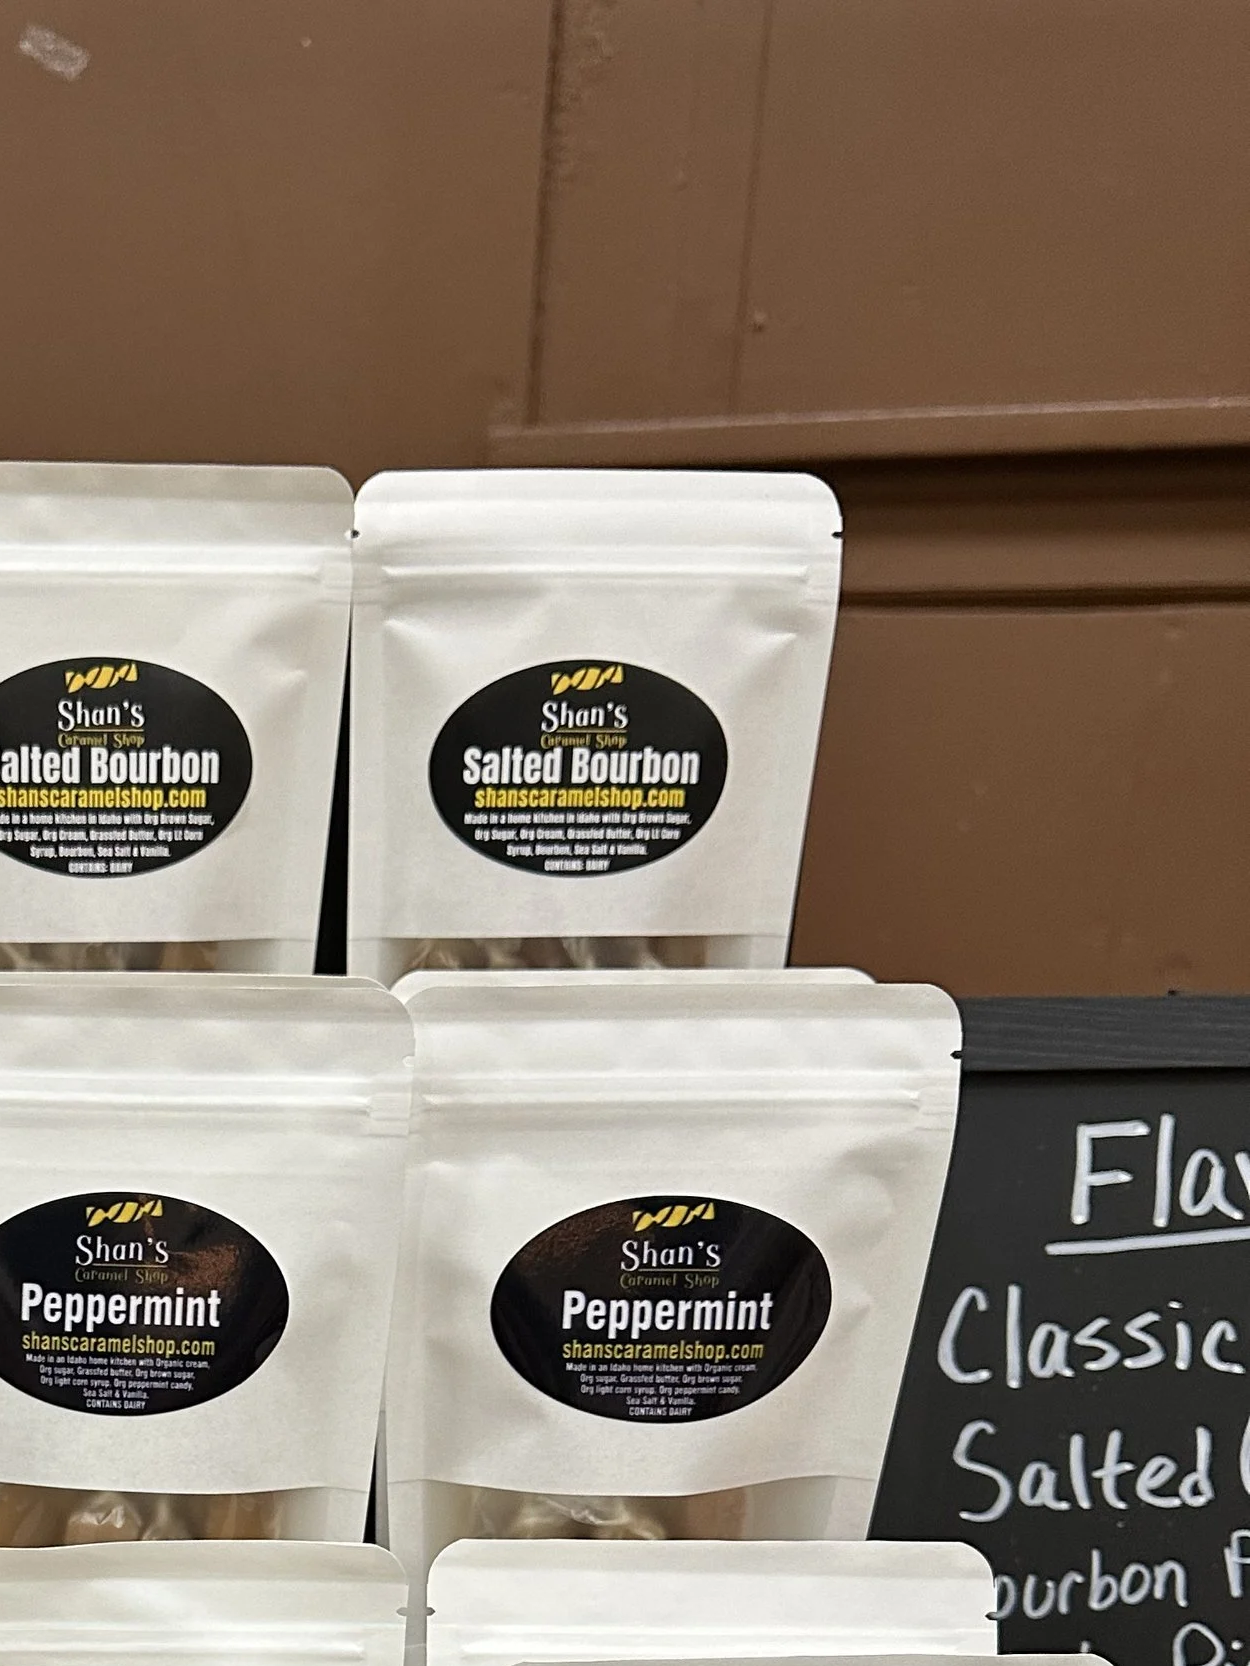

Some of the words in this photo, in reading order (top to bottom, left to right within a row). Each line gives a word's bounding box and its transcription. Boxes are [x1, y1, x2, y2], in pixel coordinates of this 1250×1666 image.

[57, 700, 144, 731] Shan's
[541, 701, 627, 732] Shan's
[57, 732, 107, 748] Caramel
[113, 733, 144, 748] Shop
[540, 733, 590, 749] Caramel
[595, 732, 626, 748] Shop
[90, 743, 219, 783] Bourbon
[462, 745, 562, 784] Salted
[571, 745, 699, 784] Bourbon
[474, 786, 684, 808] shanscaramelshop.com
[75, 1235, 168, 1266] Shan's
[620, 1239, 720, 1271] Shan's
[74, 1267, 127, 1282] Caramel
[134, 1268, 169, 1284] Shop
[619, 1272, 676, 1289] Caramel
[684, 1273, 719, 1288] Shop
[21, 1282, 220, 1332] Peppermint
[562, 1290, 772, 1339] Peppermint
[22, 1330, 214, 1357] shanscaramelshop.com
[938, 1284, 1246, 1389] Classic
[25, 1353, 45, 1362] Made
[66, 1355, 87, 1364] Idaho
[88, 1356, 108, 1365] home
[109, 1356, 136, 1365] kitchen
[138, 1357, 154, 1366] with
[155, 1357, 183, 1368] Organic
[562, 1340, 763, 1363] shanscaramelshop.com
[39, 1364, 52, 1375] Org
[76, 1366, 108, 1376] Grassfed
[135, 1367, 148, 1378] Org
[149, 1369, 171, 1377] brown
[40, 1374, 52, 1386] Org
[54, 1376, 70, 1386] light
[113, 1377, 126, 1389] Org
[127, 1380, 168, 1389] peppermint
[82, 1387, 96, 1397] Sea
[98, 1388, 112, 1397] Salt
[114, 1389, 120, 1398] &
[86, 1398, 121, 1408] CONTAINS
[123, 1400, 145, 1409] DAIRY
[953, 1419, 1215, 1523] Salted
